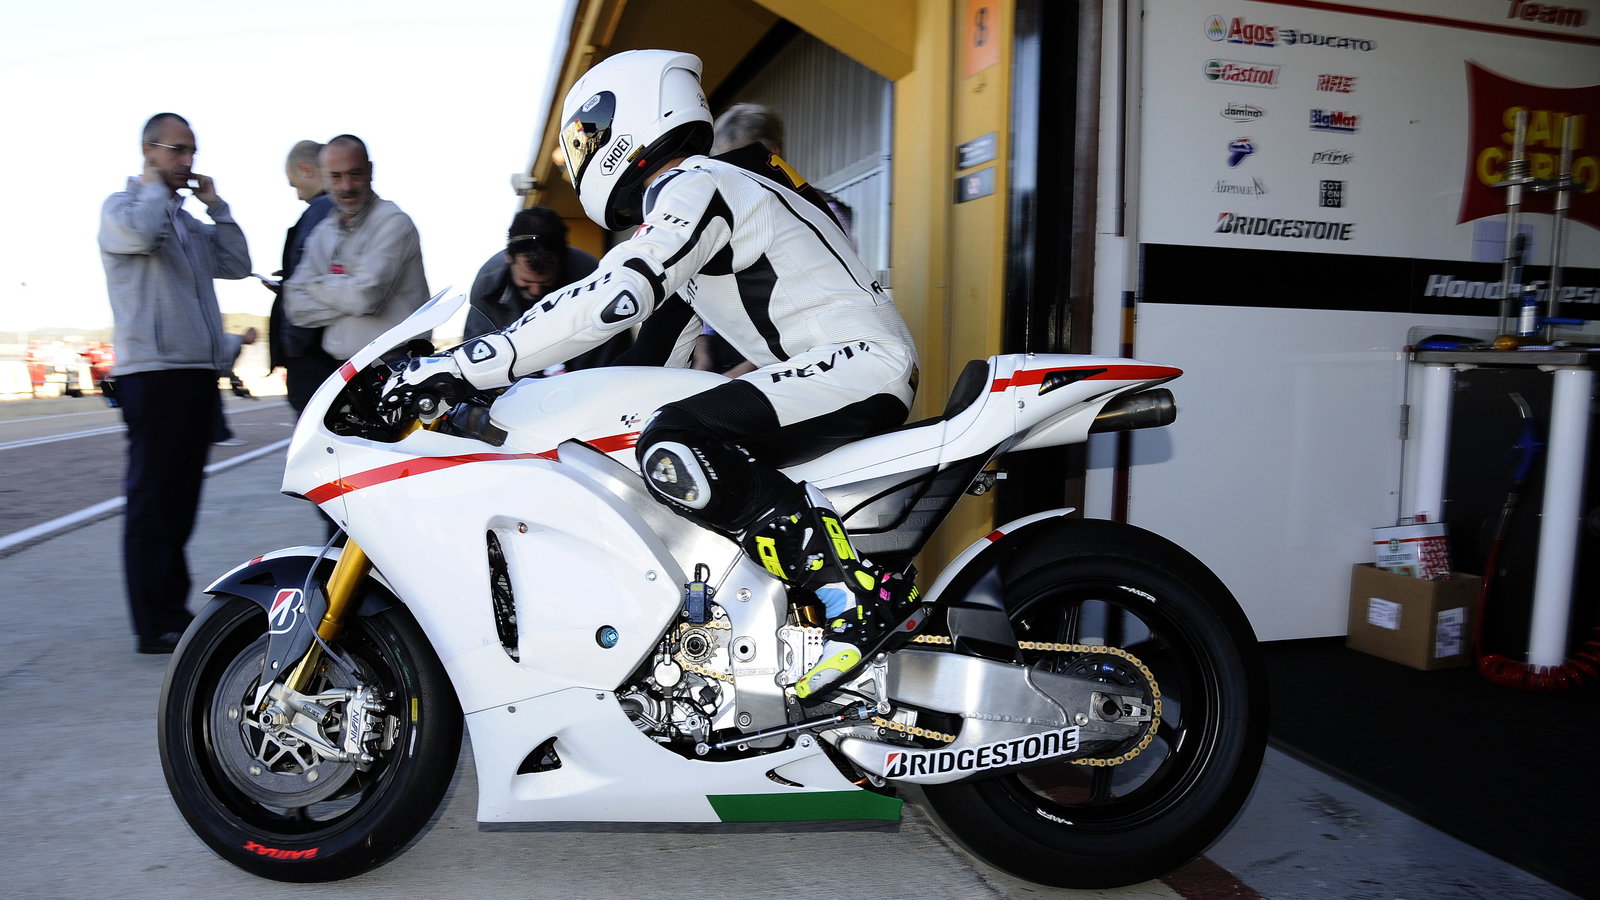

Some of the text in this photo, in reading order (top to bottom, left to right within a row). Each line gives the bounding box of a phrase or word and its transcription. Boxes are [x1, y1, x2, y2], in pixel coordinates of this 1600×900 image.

[1507, 0, 1587, 27] Team
[1227, 17, 1374, 51] Agos DUCATO
[1221, 64, 1275, 85] Castrol
[1316, 74, 1357, 93] RIFLE
[1224, 103, 1263, 119] domino
[1309, 109, 1358, 128] BigMat
[603, 138, 630, 172] SHOEI
[1312, 150, 1352, 165] prink
[1476, 147, 1600, 194] CRO
[1215, 212, 1354, 240] BRIDGESTONE
[886, 729, 1076, 778] BRIDGESTONE
